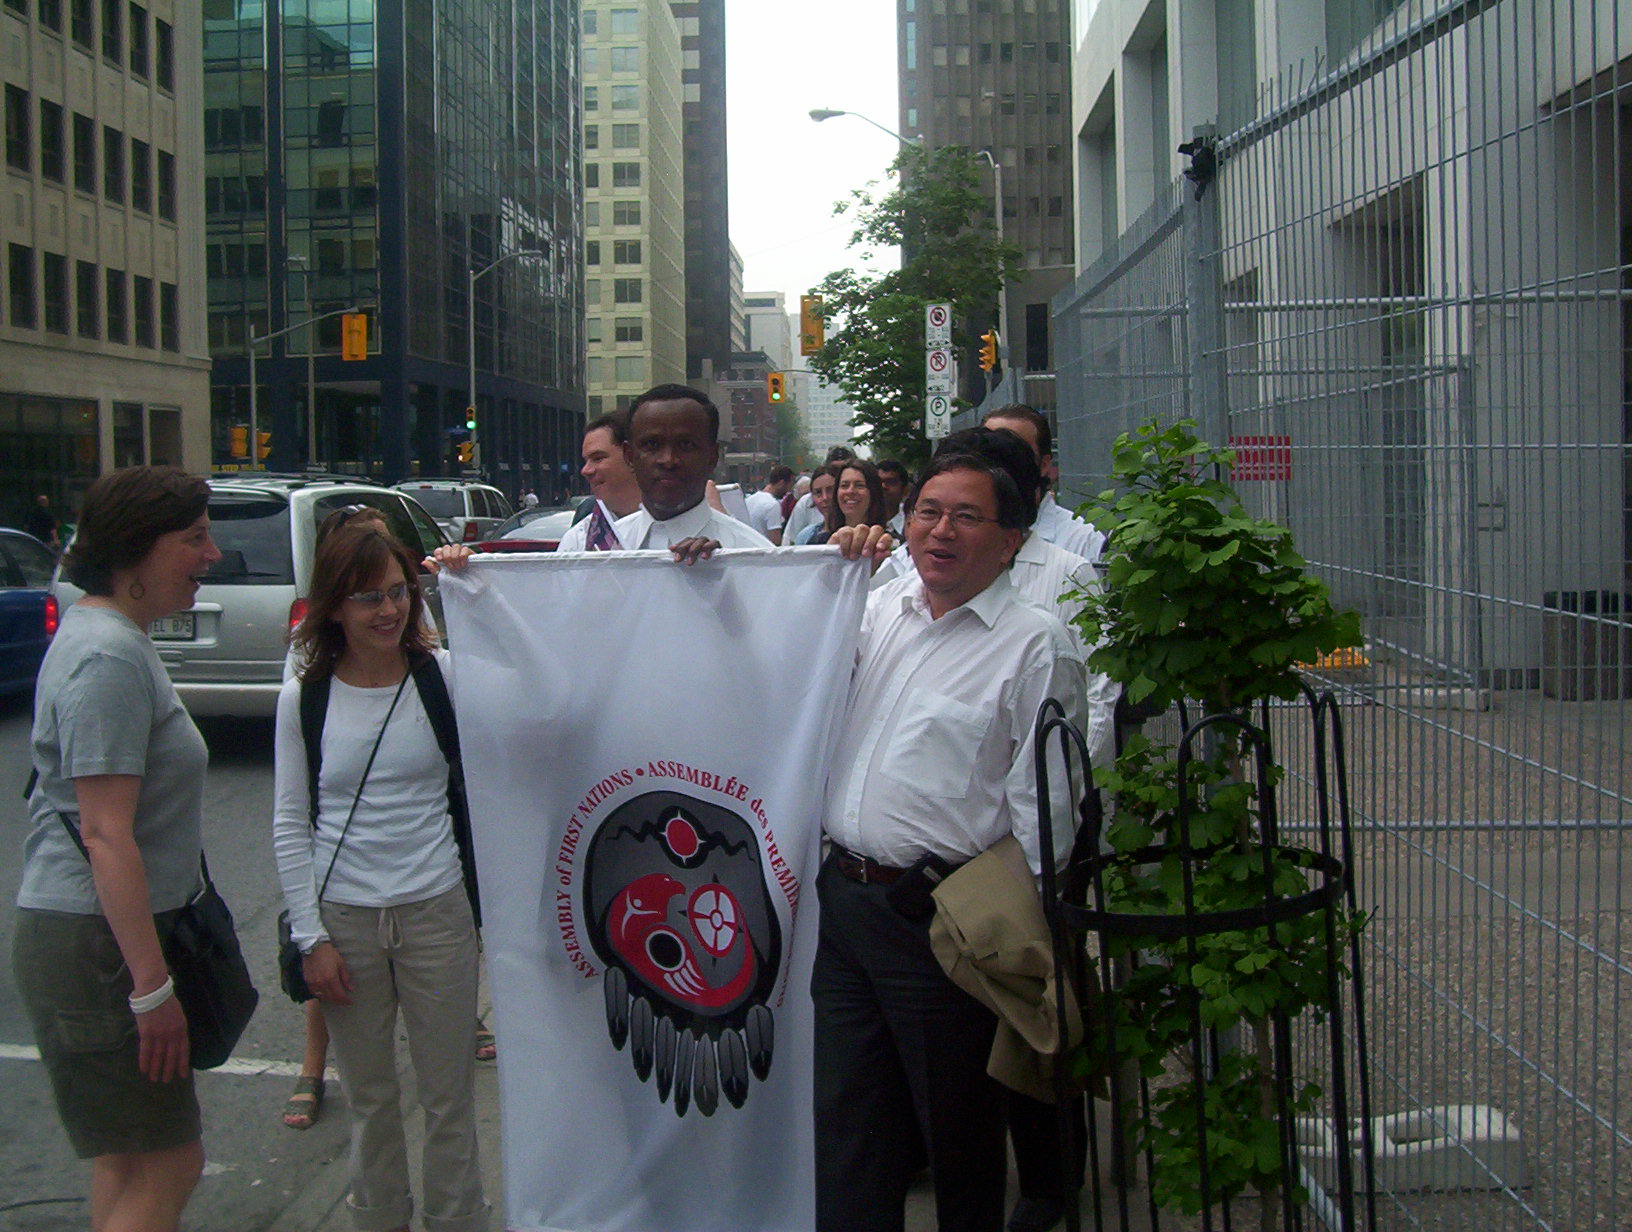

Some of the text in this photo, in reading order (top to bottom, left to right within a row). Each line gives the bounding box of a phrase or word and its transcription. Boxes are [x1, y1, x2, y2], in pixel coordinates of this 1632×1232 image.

[648, 760, 749, 802] ASSEMBLÉE
[750, 798, 769, 830] des
[555, 769, 634, 979] ASSEMBLY of FIRST NATIONS
